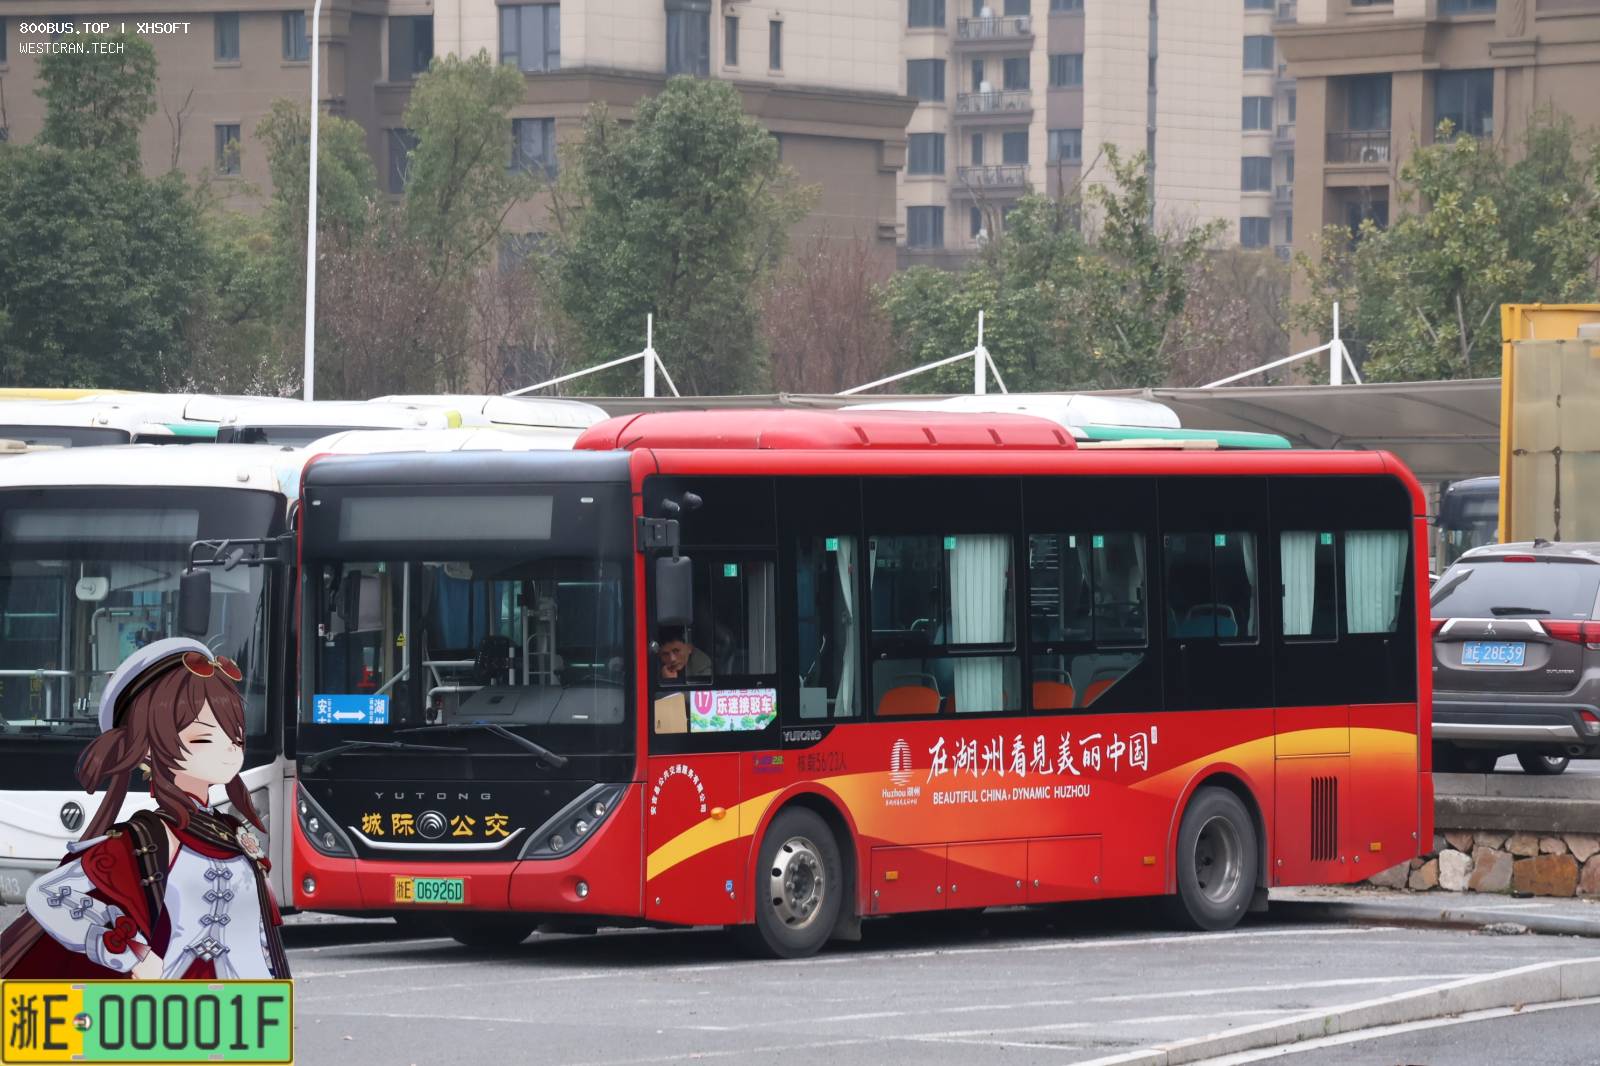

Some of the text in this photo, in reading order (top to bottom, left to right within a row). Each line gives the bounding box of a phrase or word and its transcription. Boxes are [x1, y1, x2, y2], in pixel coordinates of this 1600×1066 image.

[697, 691, 710, 708] 17
[783, 730, 823, 742] YUTONG
[375, 792, 491, 800] YUTONG
[933, 791, 978, 805] BEAUTIFUL
[1013, 786, 1051, 800] DYNAMIC
[1054, 784, 1090, 798] HUZHOU
[361, 812, 511, 837] 城际 公交
